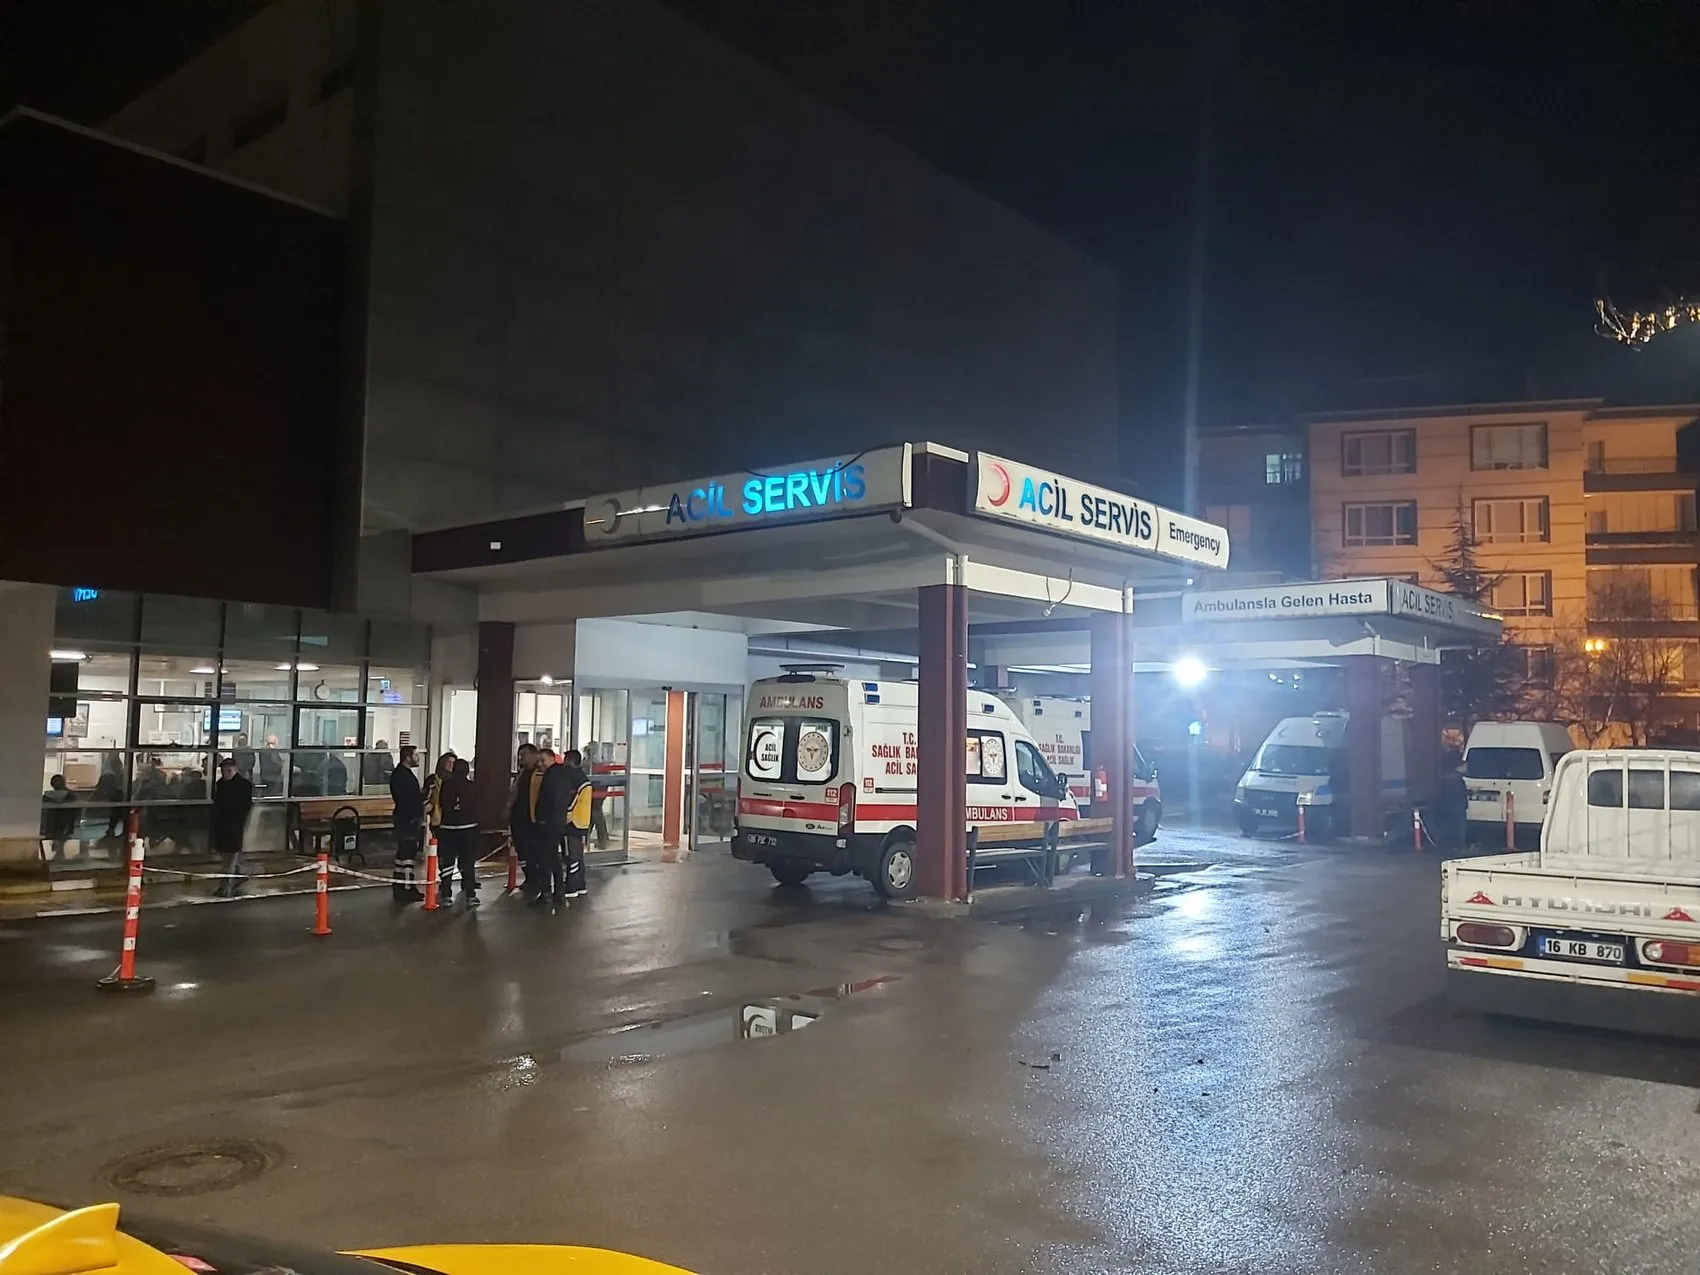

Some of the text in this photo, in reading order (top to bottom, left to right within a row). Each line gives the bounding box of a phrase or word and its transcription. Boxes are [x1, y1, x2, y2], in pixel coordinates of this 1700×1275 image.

[666, 459, 865, 525] ACİL SERVİS
[1019, 477, 1151, 540] ACİL SERVİS
[1169, 522, 1221, 555] Emergency
[1194, 592, 1373, 613] Ambulansla Gelen Hasta
[760, 696, 824, 709] AMBULANS
[903, 732, 917, 745] T.C.
[765, 743, 777, 752] ACİL
[872, 743, 902, 758] SAĞLIK
[761, 753, 779, 762] SAĞLIK
[886, 758, 917, 775] ACİL SA
[827, 789, 837, 797] 112
[966, 807, 1008, 820] MBULANS
[1547, 940, 1621, 960] 16 KB 870
